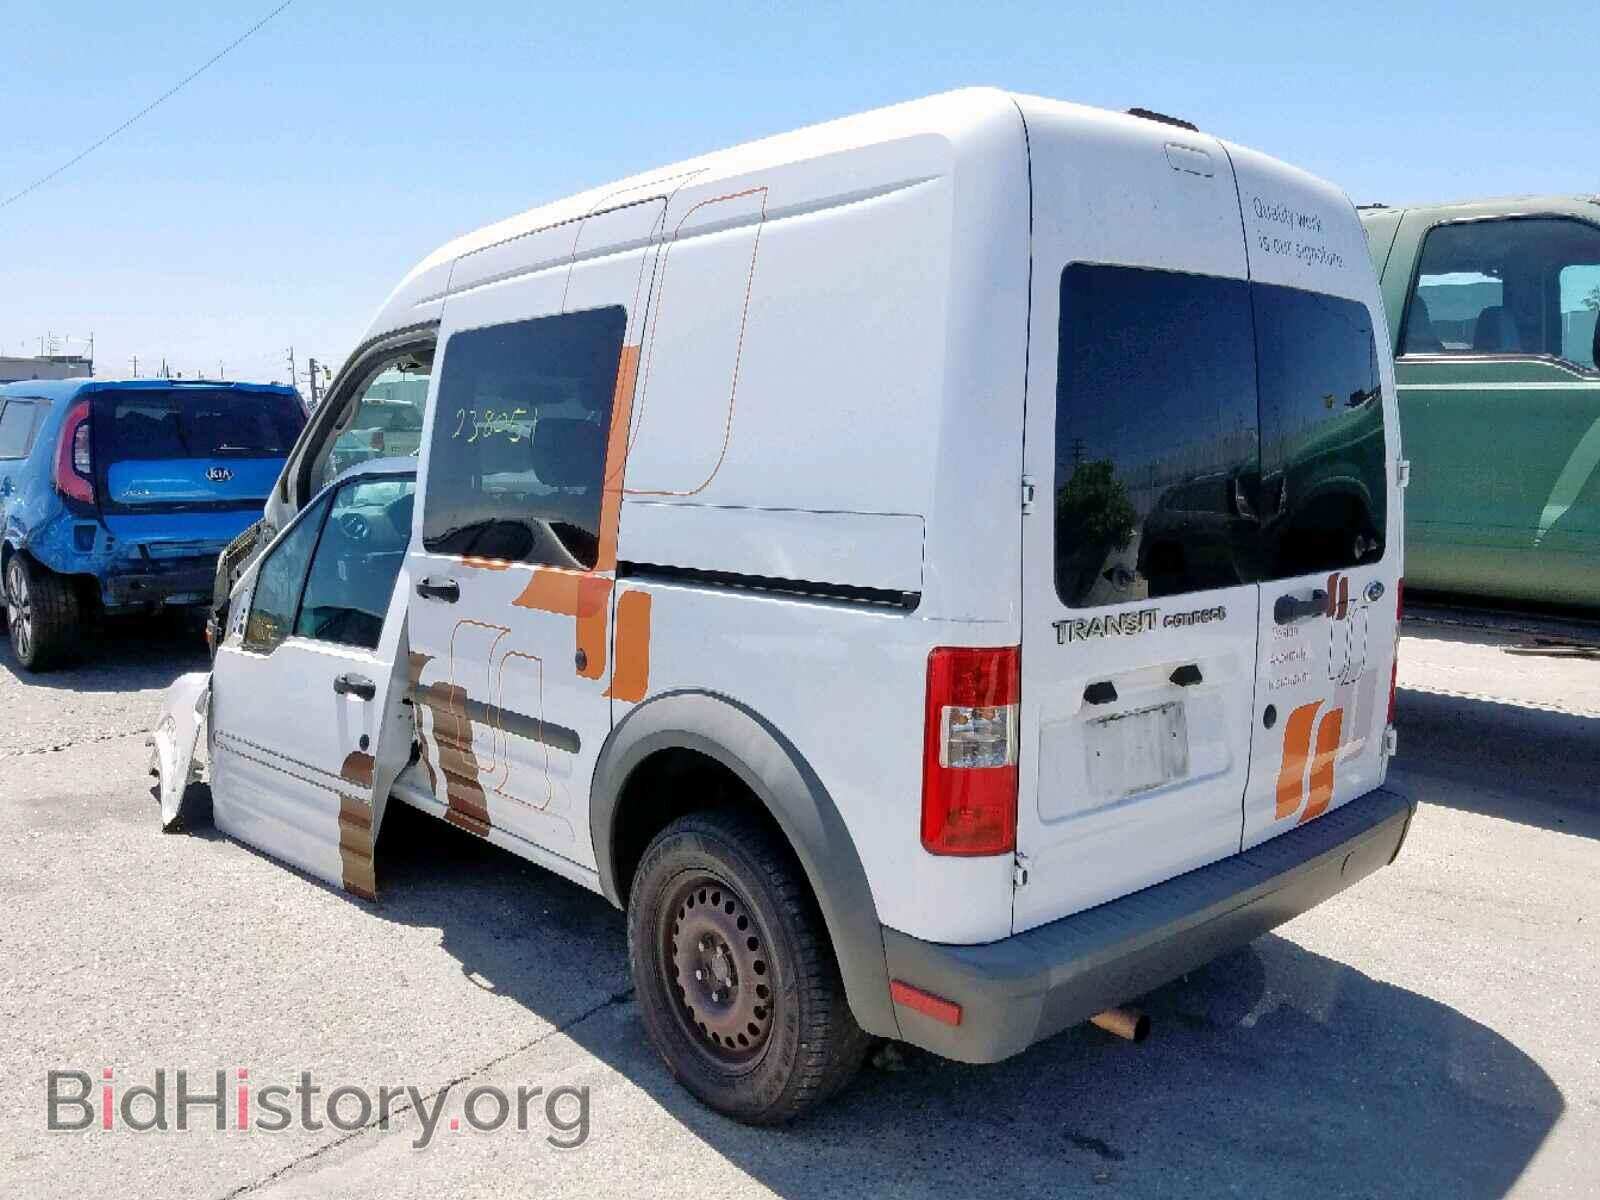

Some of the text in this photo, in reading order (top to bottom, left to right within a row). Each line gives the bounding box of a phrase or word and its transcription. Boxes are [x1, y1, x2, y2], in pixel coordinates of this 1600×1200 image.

[207, 467, 232, 481] KIA
[1052, 605, 1227, 645] TRANSIT connect
